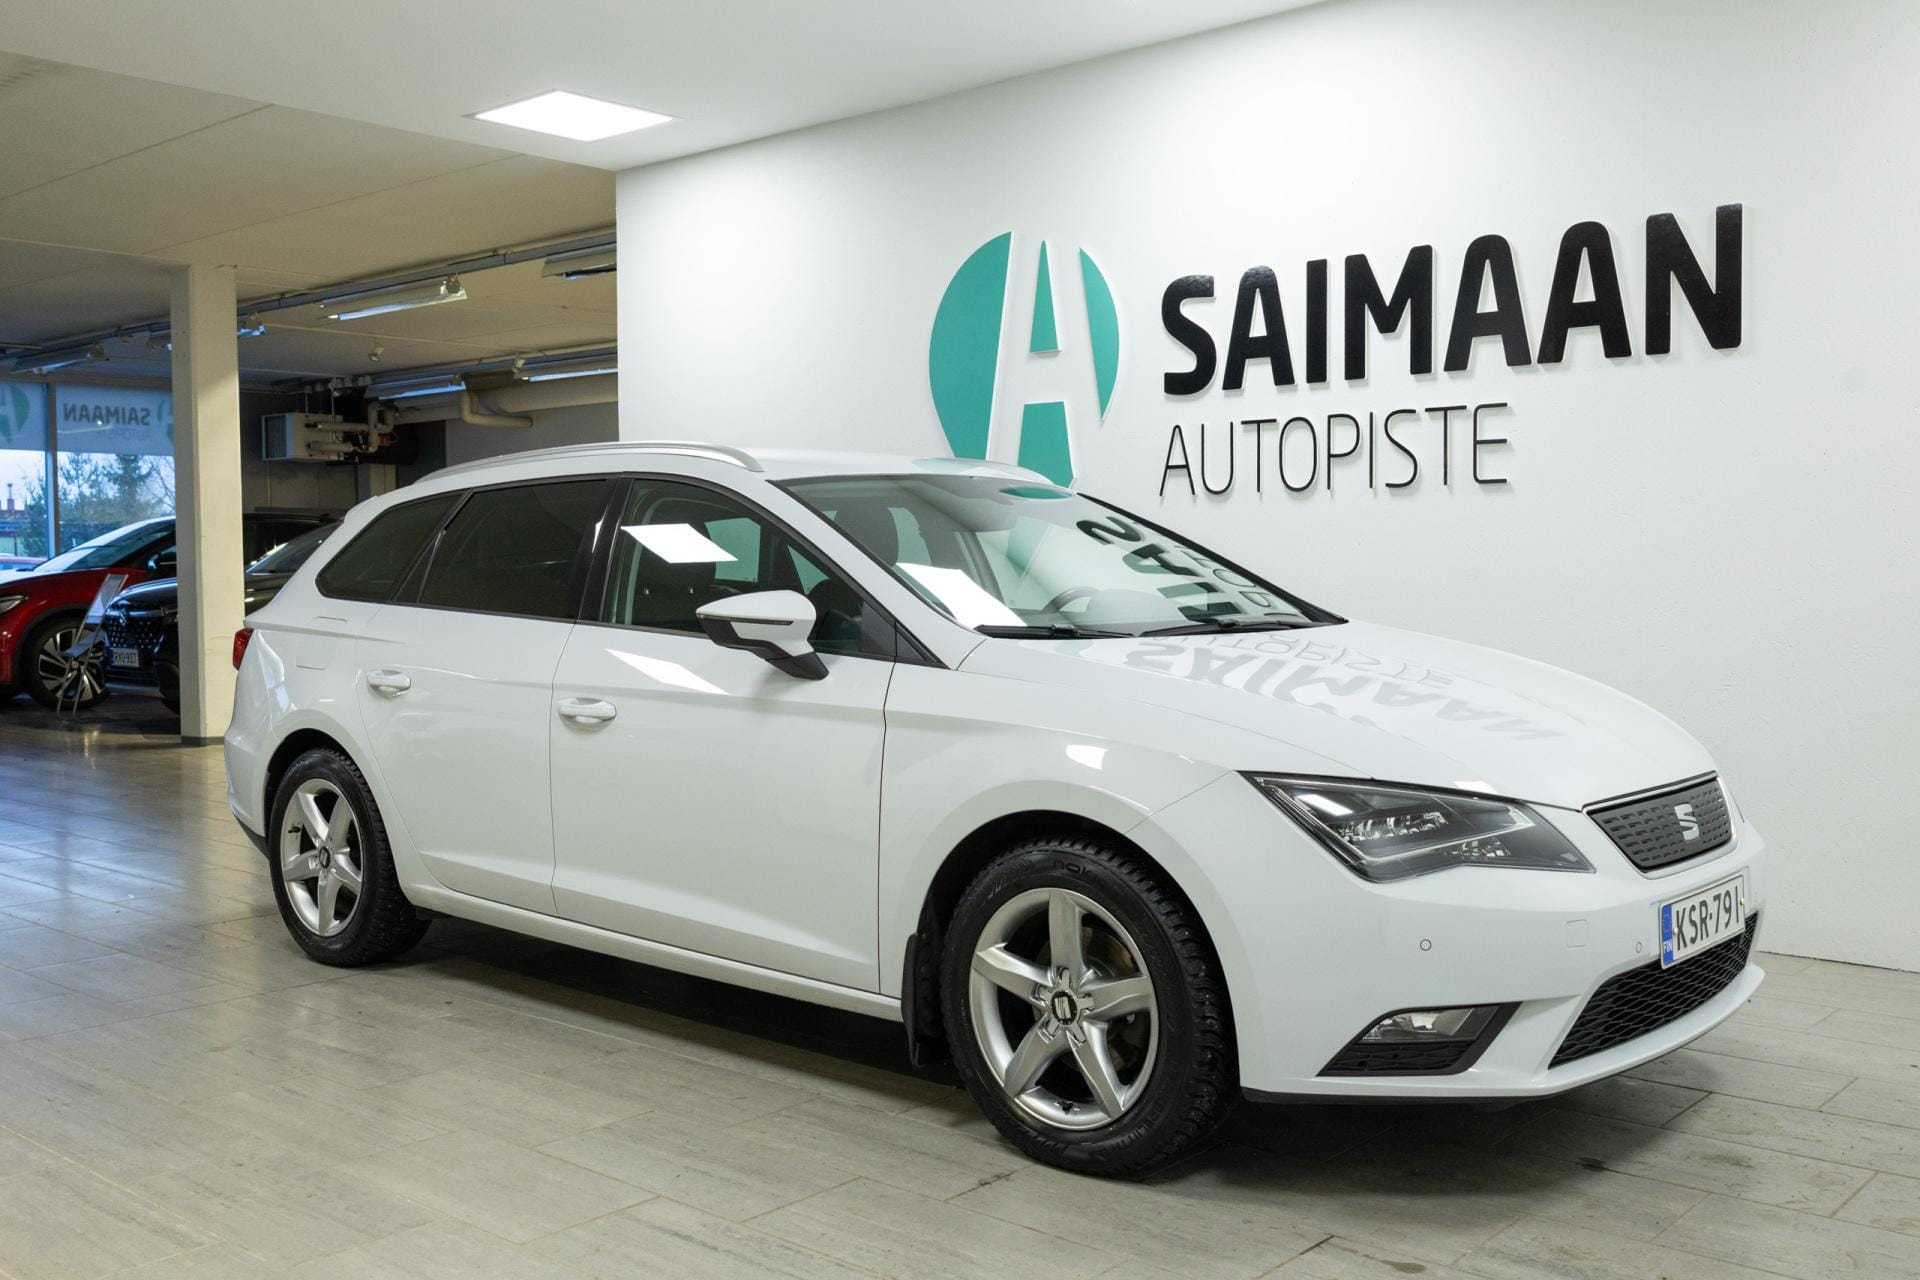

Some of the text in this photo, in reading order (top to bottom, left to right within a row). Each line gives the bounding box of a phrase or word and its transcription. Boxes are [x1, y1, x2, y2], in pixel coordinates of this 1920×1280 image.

[1162, 203, 1743, 396] SAIMAAN
[1159, 402, 1509, 497] AUTOPISTE
[1663, 885, 1740, 954] FIN KSR-791
